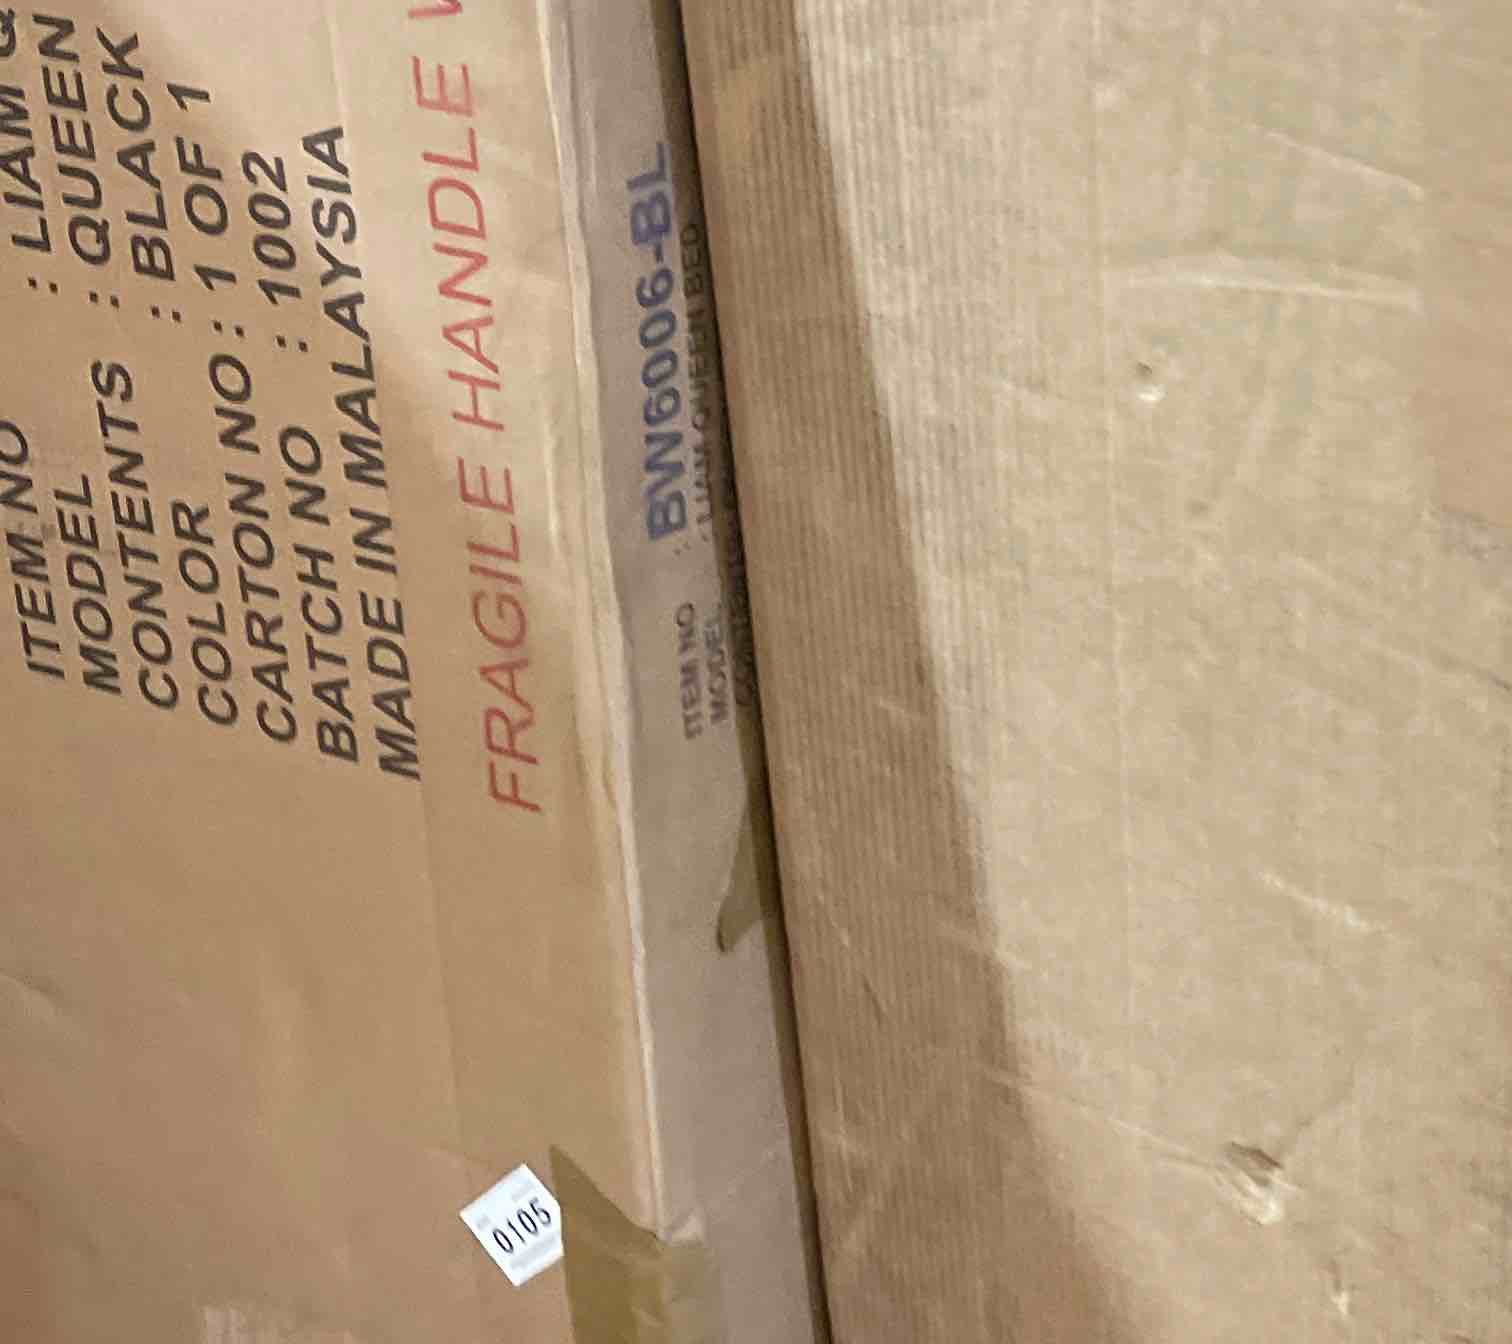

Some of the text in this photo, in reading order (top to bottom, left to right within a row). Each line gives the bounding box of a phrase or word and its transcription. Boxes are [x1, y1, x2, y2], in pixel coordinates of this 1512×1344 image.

[32, 13, 111, 267] QUEEN
[96, 24, 176, 282] BLACK
[166, 82, 212, 111] 1
[175, 136, 230, 237] OF
[194, 263, 238, 291] 1
[241, 150, 302, 306] 1002
[412, 55, 505, 431] HANDLE
[626, 142, 688, 543] BW6006-BL
[0, 420, 66, 680] ITEM NO
[91, 359, 180, 711] CONTENTS
[278, 425, 331, 527] NO
[301, 126, 422, 782] MADE IN MALAYSIA
[54, 474, 122, 696] MODEL
[171, 499, 240, 727] COLOR
[225, 472, 299, 745] CARTON
[292, 543, 359, 764] BATCH
[457, 456, 542, 813] FRAGILE
[493, 1197, 552, 1254] 0105
